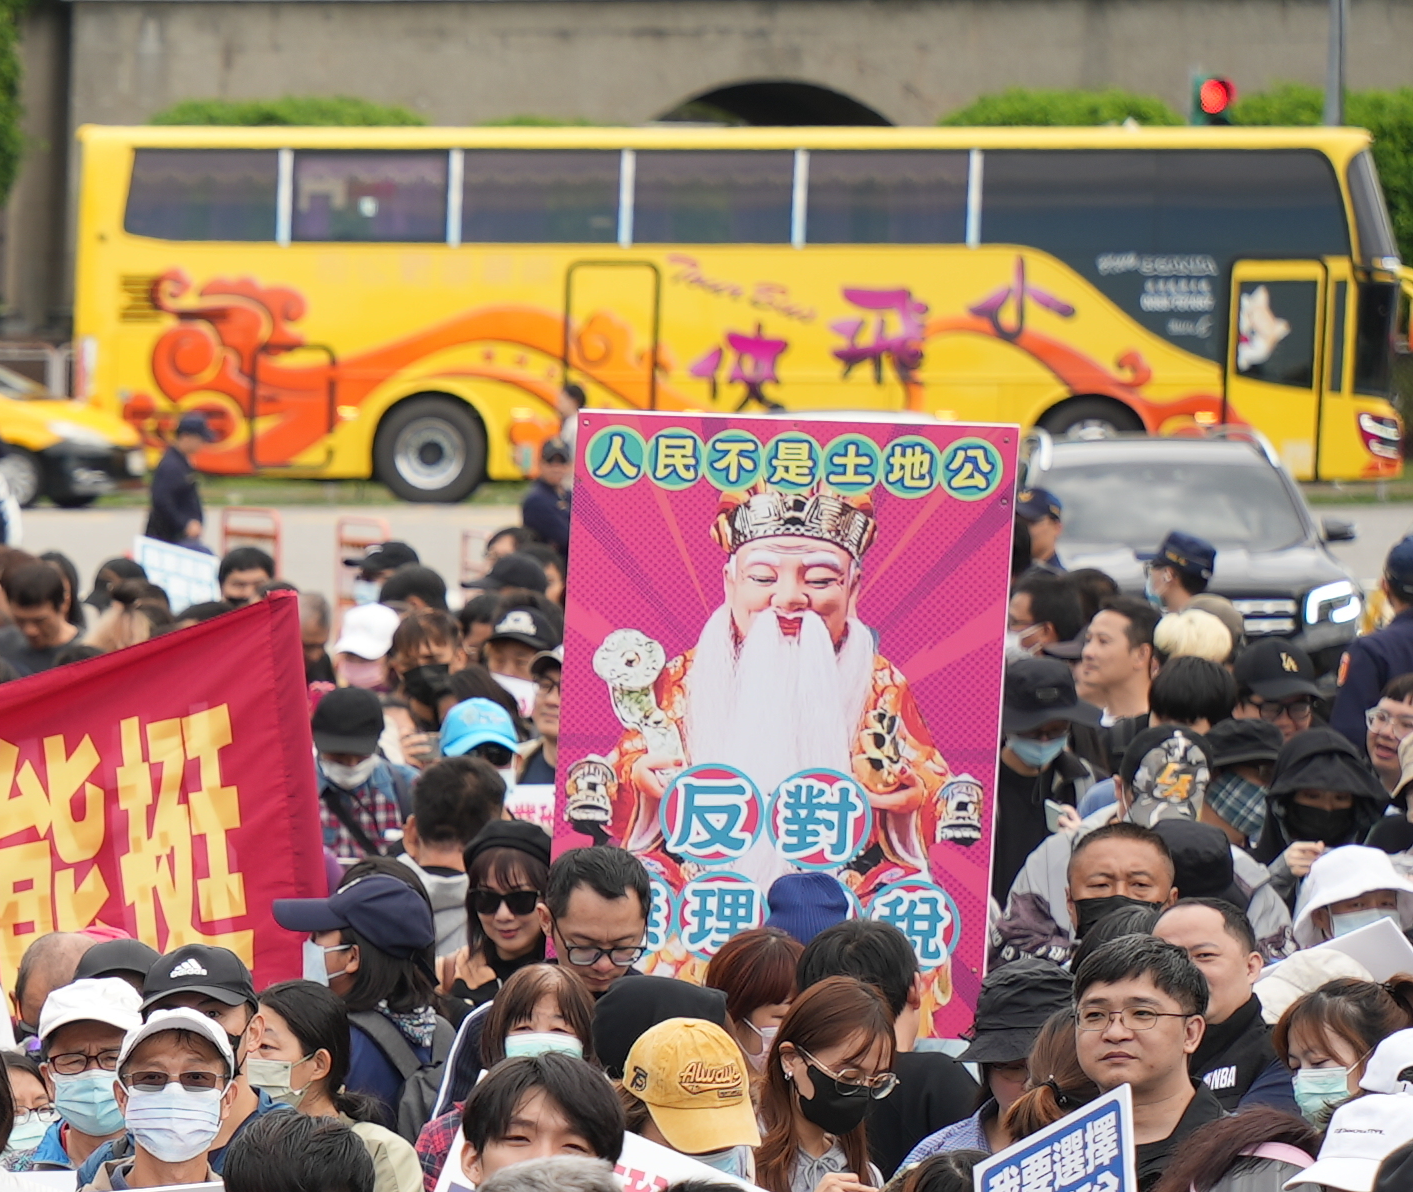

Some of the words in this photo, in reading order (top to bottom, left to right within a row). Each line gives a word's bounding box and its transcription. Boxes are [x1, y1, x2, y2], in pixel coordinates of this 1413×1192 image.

[593, 431, 996, 491] 人民不是土地公
[671, 782, 858, 856] 反對
[1211, 1065, 1237, 1090] NBA
